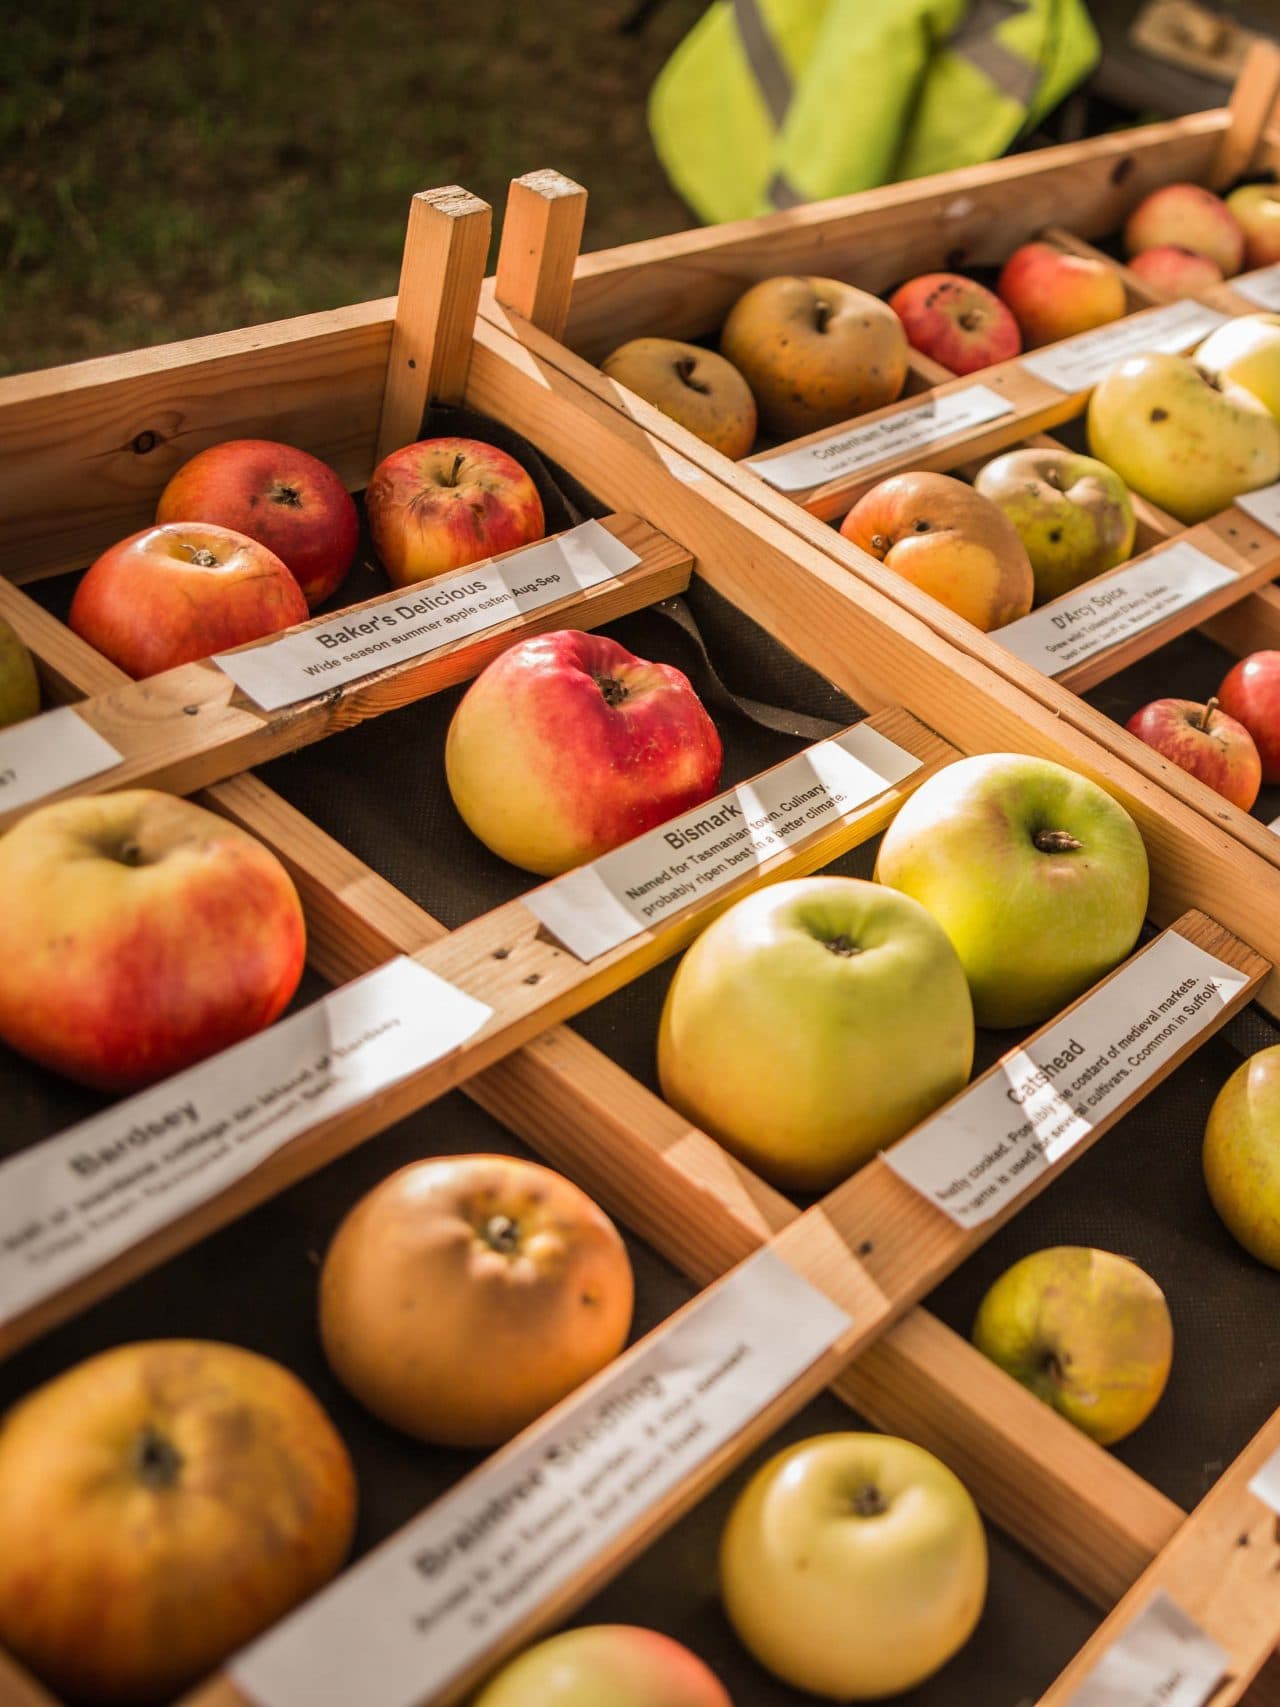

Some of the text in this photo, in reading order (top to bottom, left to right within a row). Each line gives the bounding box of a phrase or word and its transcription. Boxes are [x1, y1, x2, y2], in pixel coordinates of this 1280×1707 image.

[302, 574, 561, 676] Wide season summer apple eaten Aug-Sep
[315, 581, 488, 649] Baker's Delicious
[1050, 604, 1097, 630] D'Arcy
[1090, 587, 1129, 608] Spice
[625, 870, 673, 900] Named
[669, 862, 690, 876] for
[686, 827, 751, 864] Tasmanian
[749, 811, 784, 830] town.
[641, 794, 848, 917] probably ripen best in a better climate.
[663, 804, 743, 850] Bismark
[968, 1142, 1011, 1179] cooked.
[1007, 1105, 1057, 1144] Possibly
[1052, 1088, 1074, 1105] the
[1071, 1055, 1110, 1091] costard
[1107, 1044, 1121, 1059] of
[1117, 1009, 1162, 1050] medieval
[1157, 978, 1200, 1014] markets.
[1006, 1038, 1086, 1105] Catshead
[1008, 1149, 1038, 1176] used
[1031, 1136, 1051, 1155] for
[1050, 1101, 1089, 1139] several
[1086, 1068, 1133, 1107] cultivars.
[1127, 1023, 1178, 1067] Ccommon
[1172, 1014, 1188, 1025] in
[1182, 983, 1223, 1016] Suffolk.
[68, 1102, 199, 1177] Bardsey
